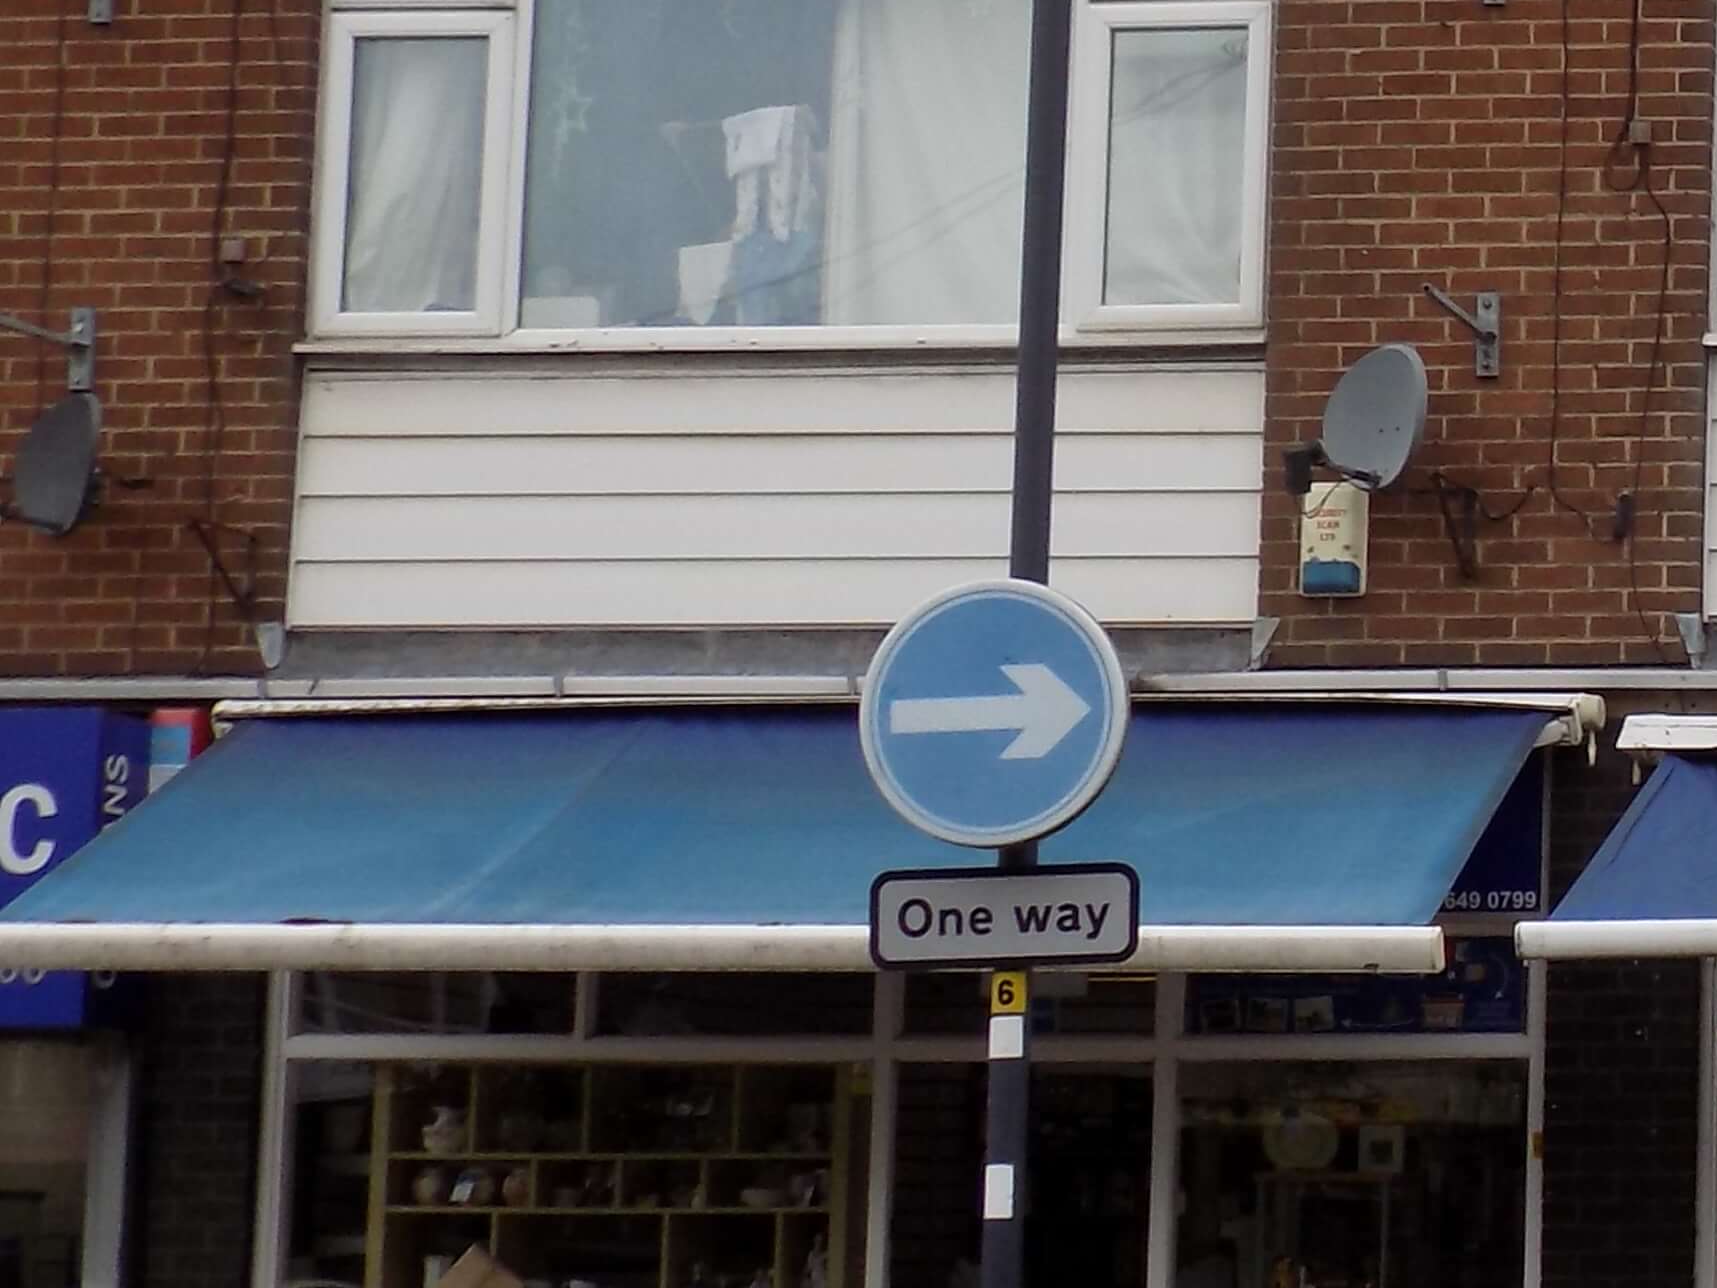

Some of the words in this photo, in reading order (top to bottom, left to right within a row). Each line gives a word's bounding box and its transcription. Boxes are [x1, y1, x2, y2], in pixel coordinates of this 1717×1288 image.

[1487, 890, 1536, 909] 0799
[898, 898, 993, 937] One
[1014, 902, 1110, 939] way
[998, 980, 1015, 1005] 6
